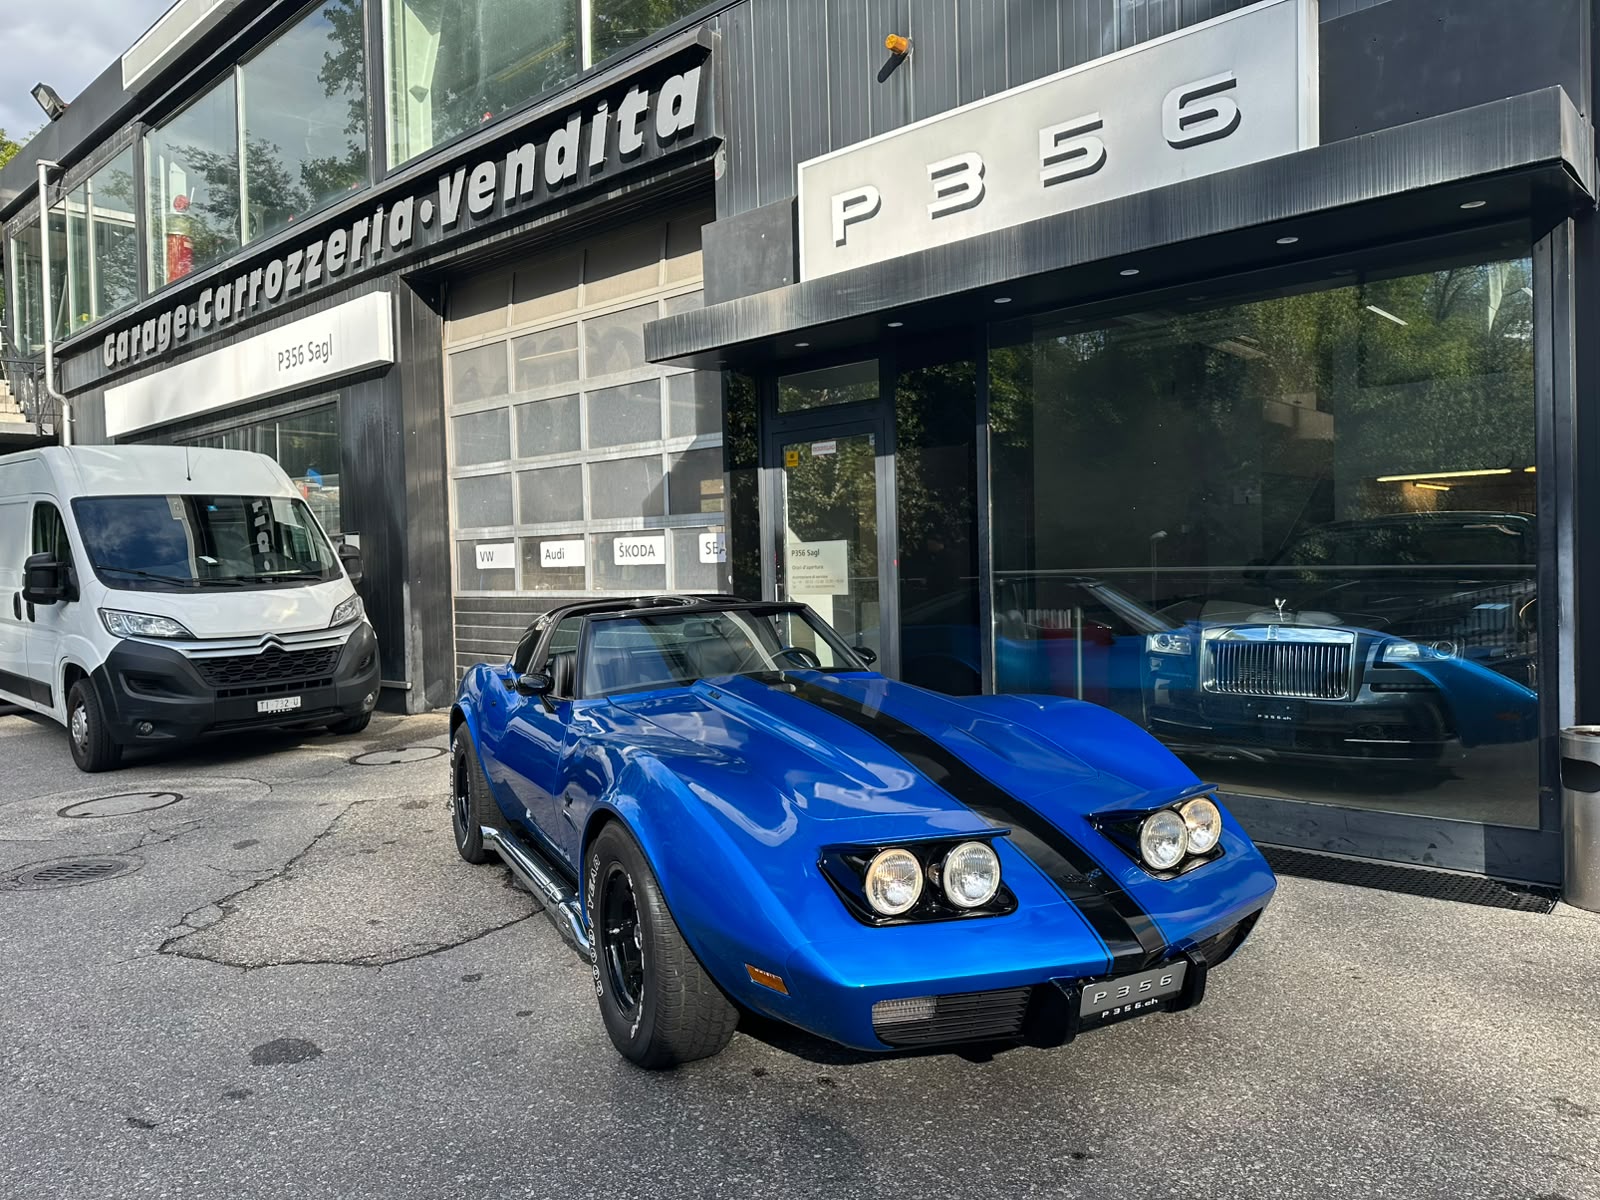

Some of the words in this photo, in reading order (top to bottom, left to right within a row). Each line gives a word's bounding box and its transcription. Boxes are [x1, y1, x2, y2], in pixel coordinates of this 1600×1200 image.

[277, 344, 304, 372] P356
[307, 333, 333, 364] Sagl
[479, 550, 494, 563] VW
[544, 546, 565, 561] Audi
[618, 541, 656, 558] ŠKODA
[791, 549, 806, 557] P356
[806, 548, 820, 558] Sagl
